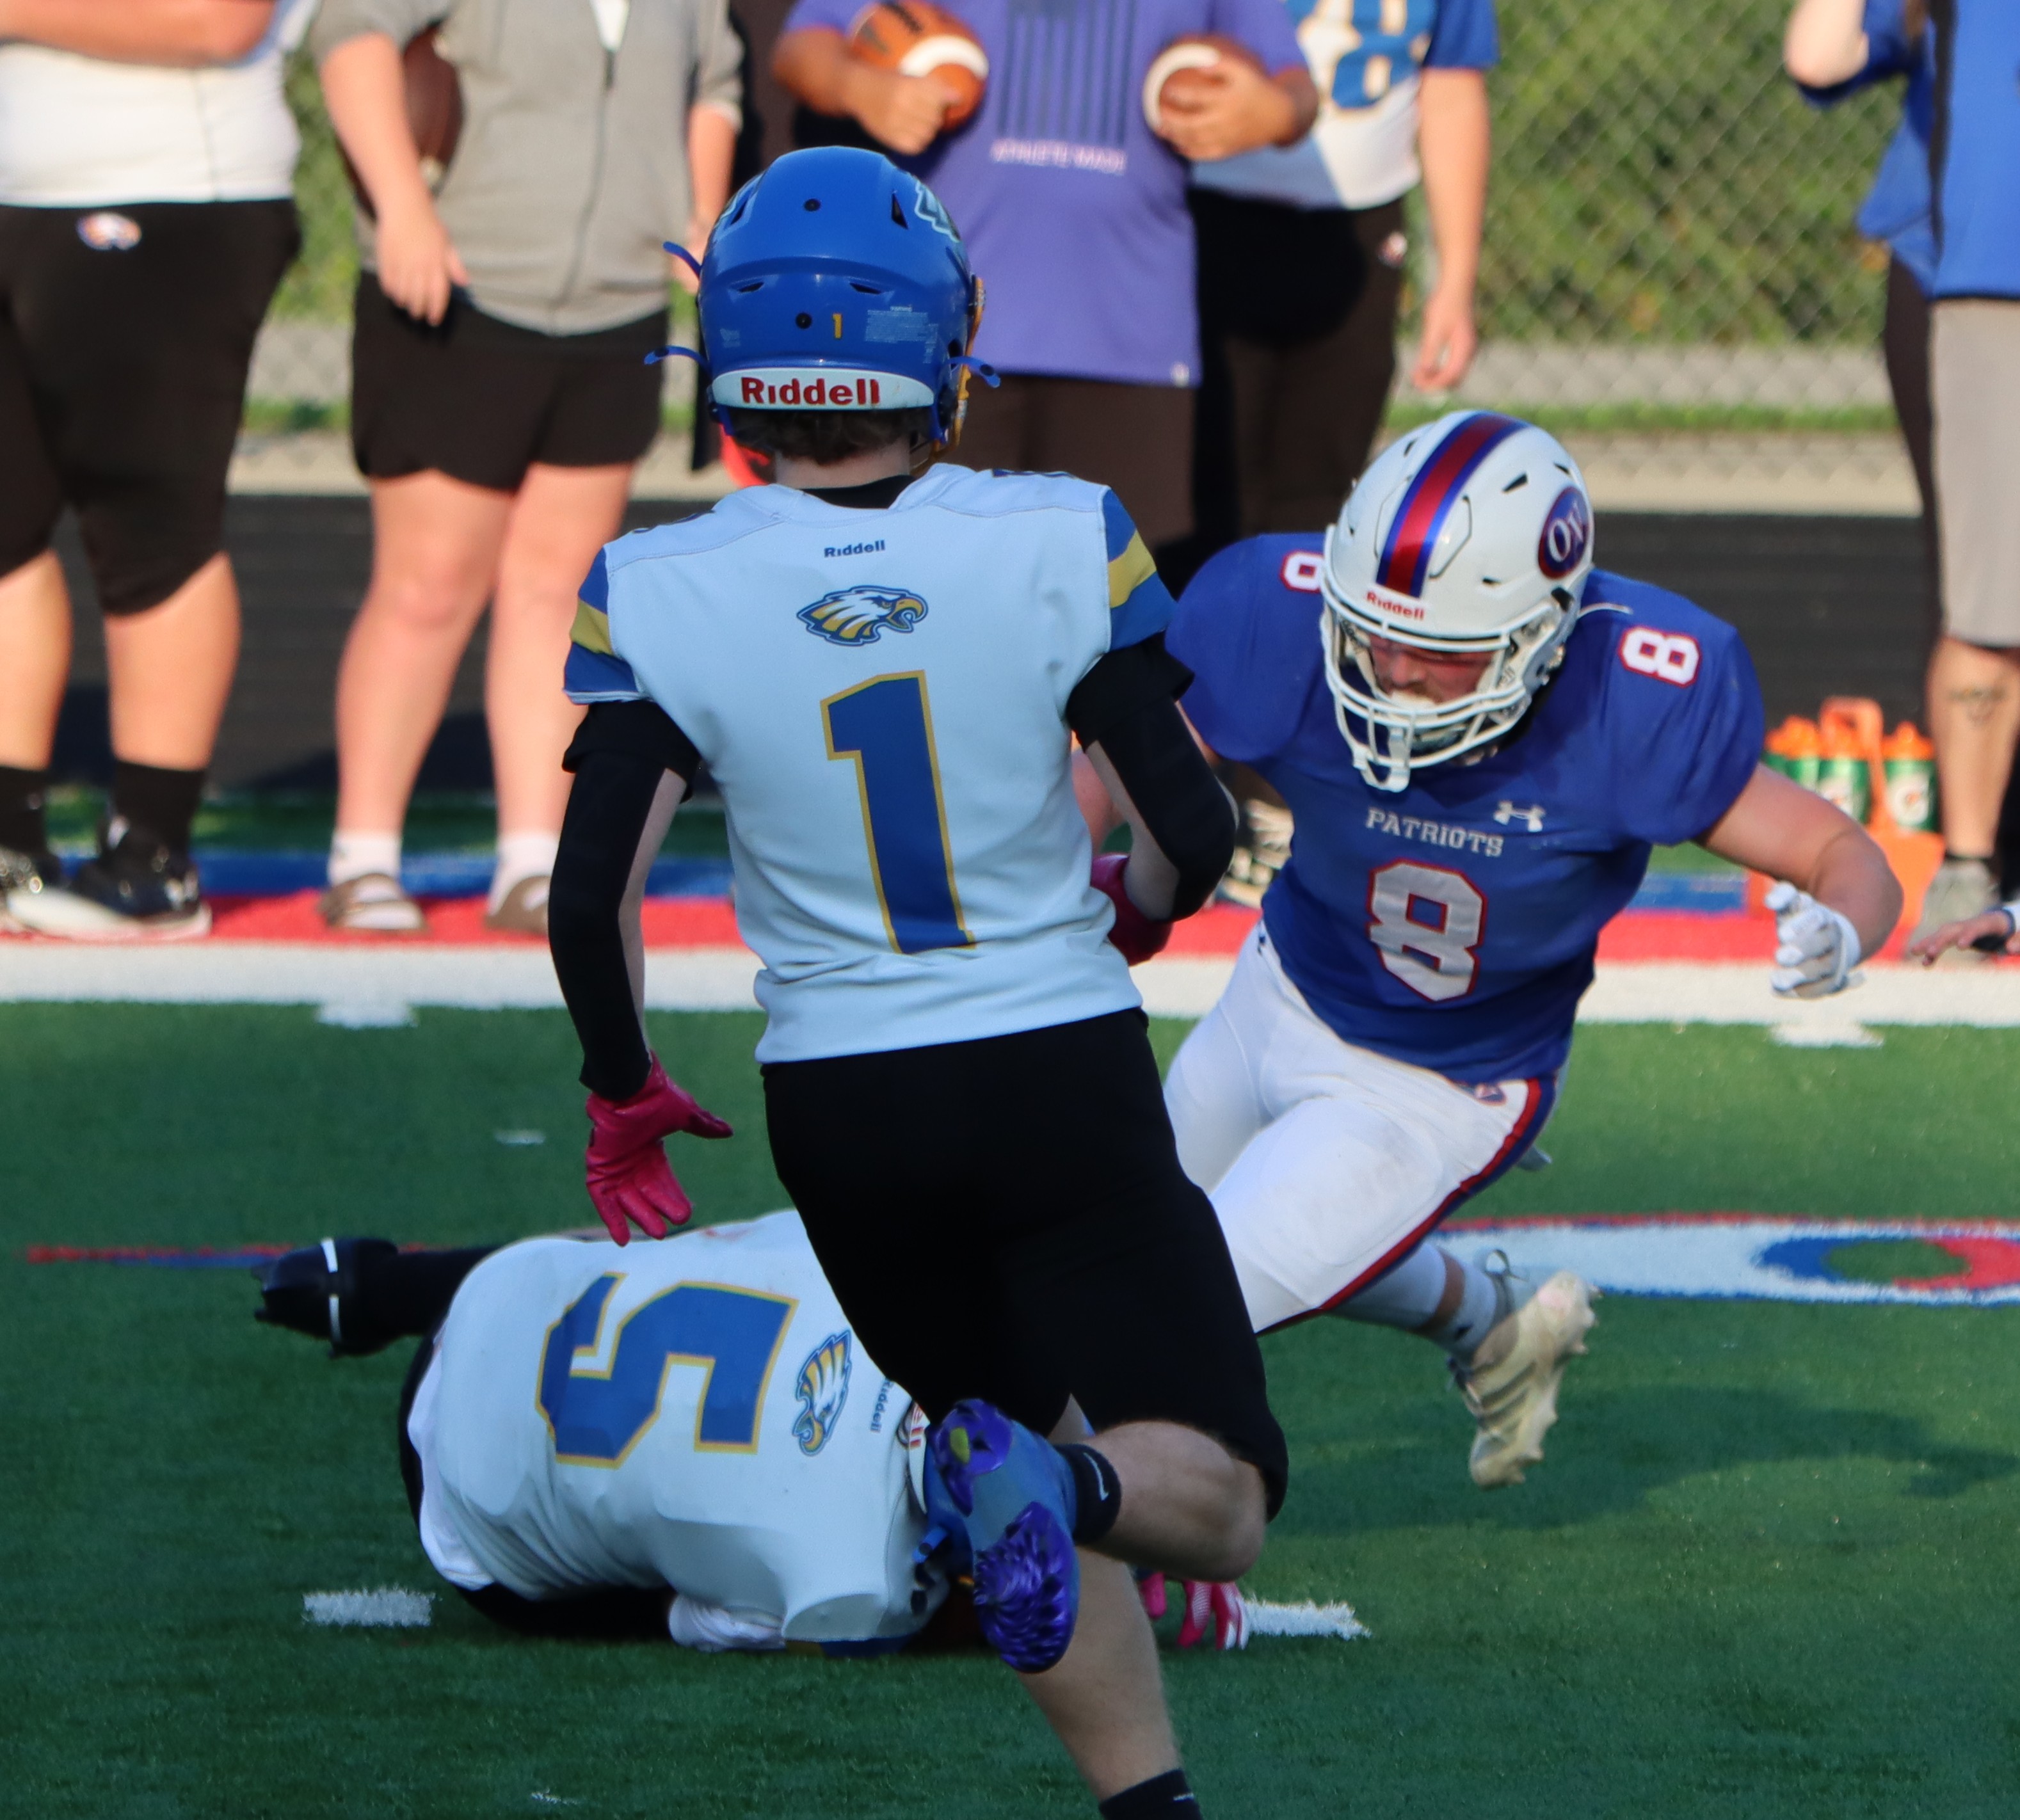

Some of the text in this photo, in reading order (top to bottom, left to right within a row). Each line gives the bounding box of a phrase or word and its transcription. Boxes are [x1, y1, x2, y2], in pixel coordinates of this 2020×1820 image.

[833, 313, 843, 339] 1
[741, 376, 881, 406] Riddell
[824, 539, 885, 557] Riddell
[1367, 590, 1425, 621] Riddell
[1618, 625, 1703, 689] 8
[820, 670, 976, 954] 1
[1366, 806, 1504, 857] PATRIOTS
[1365, 857, 1488, 1003] 8
[534, 1271, 800, 1469] 5
